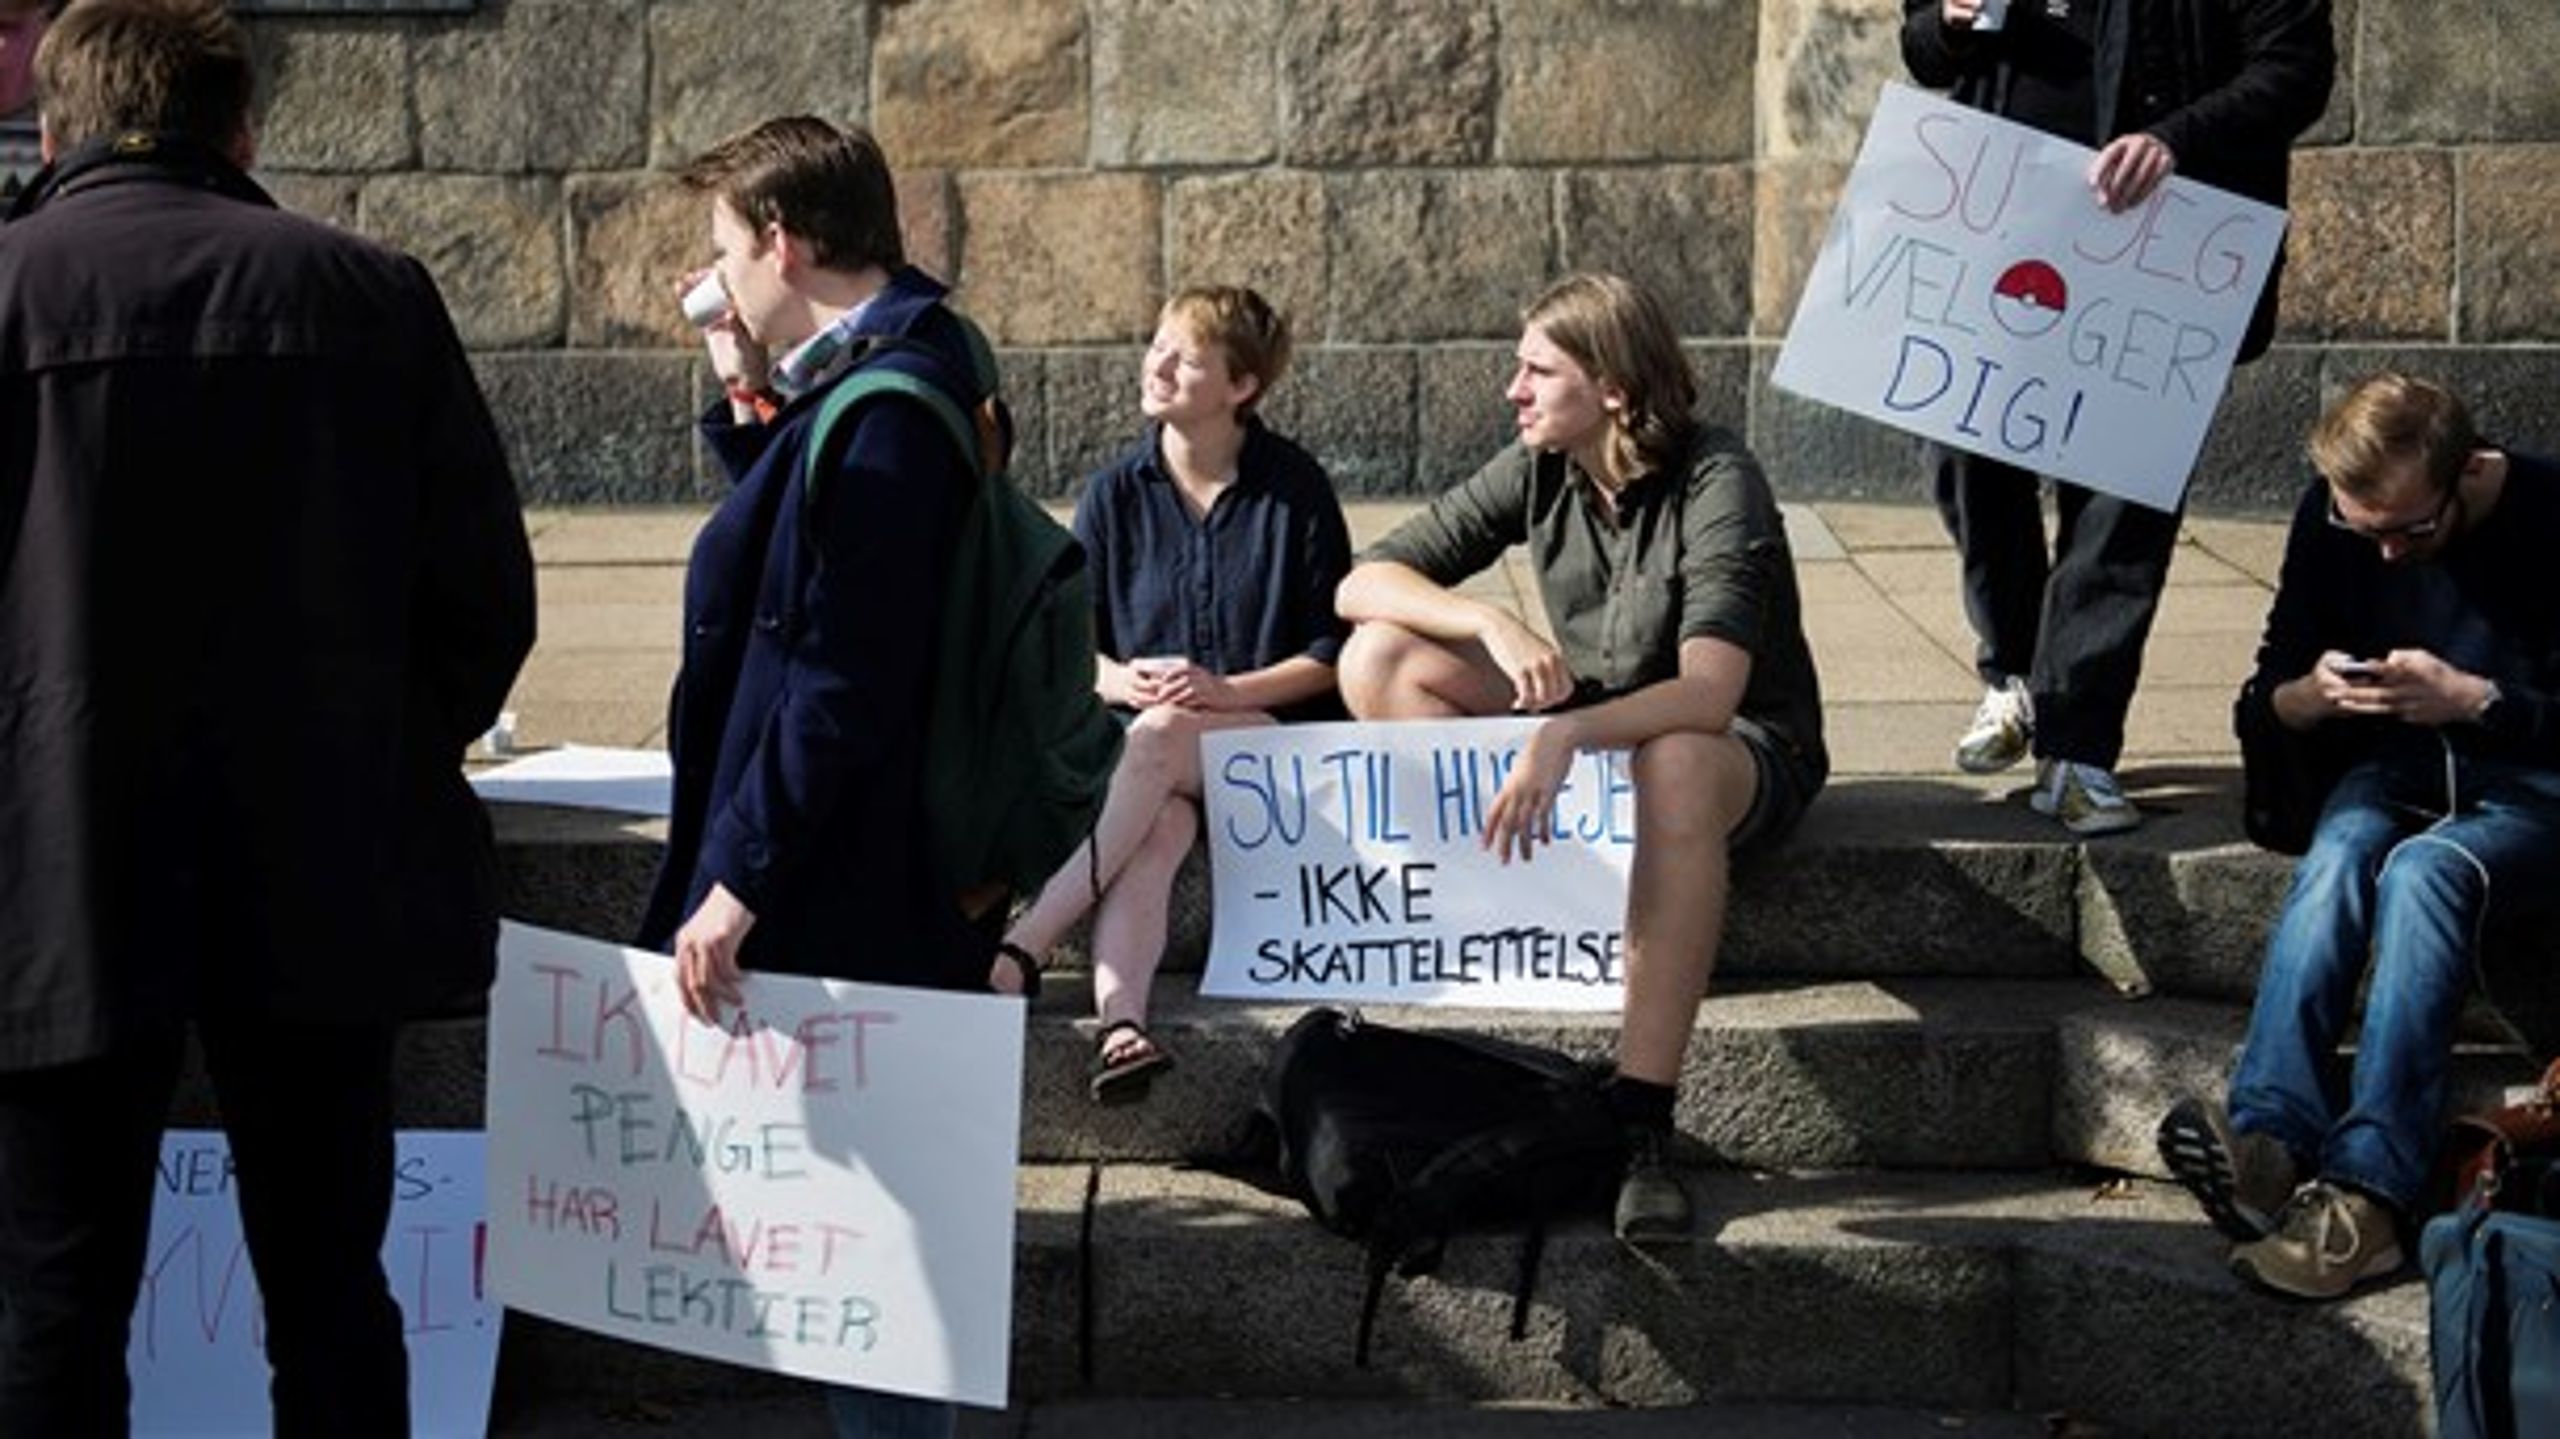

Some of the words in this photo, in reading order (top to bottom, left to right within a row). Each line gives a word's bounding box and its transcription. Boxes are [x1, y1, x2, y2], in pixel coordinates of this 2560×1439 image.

[2071, 186, 2257, 295] JEG
[1882, 334, 2084, 461] DIG!
[1222, 751, 1308, 851] SU
[1321, 748, 1411, 845] TIL
[1299, 863, 1438, 928] IKKE
[1247, 926, 1627, 987] SKATTELETTELSE
[679, 1008, 896, 1095] LAVET
[569, 1082, 809, 1182] PENGE
[526, 1173, 620, 1242] HAR
[649, 1187, 865, 1276] LAVET
[606, 1261, 882, 1353] LEKTIER
